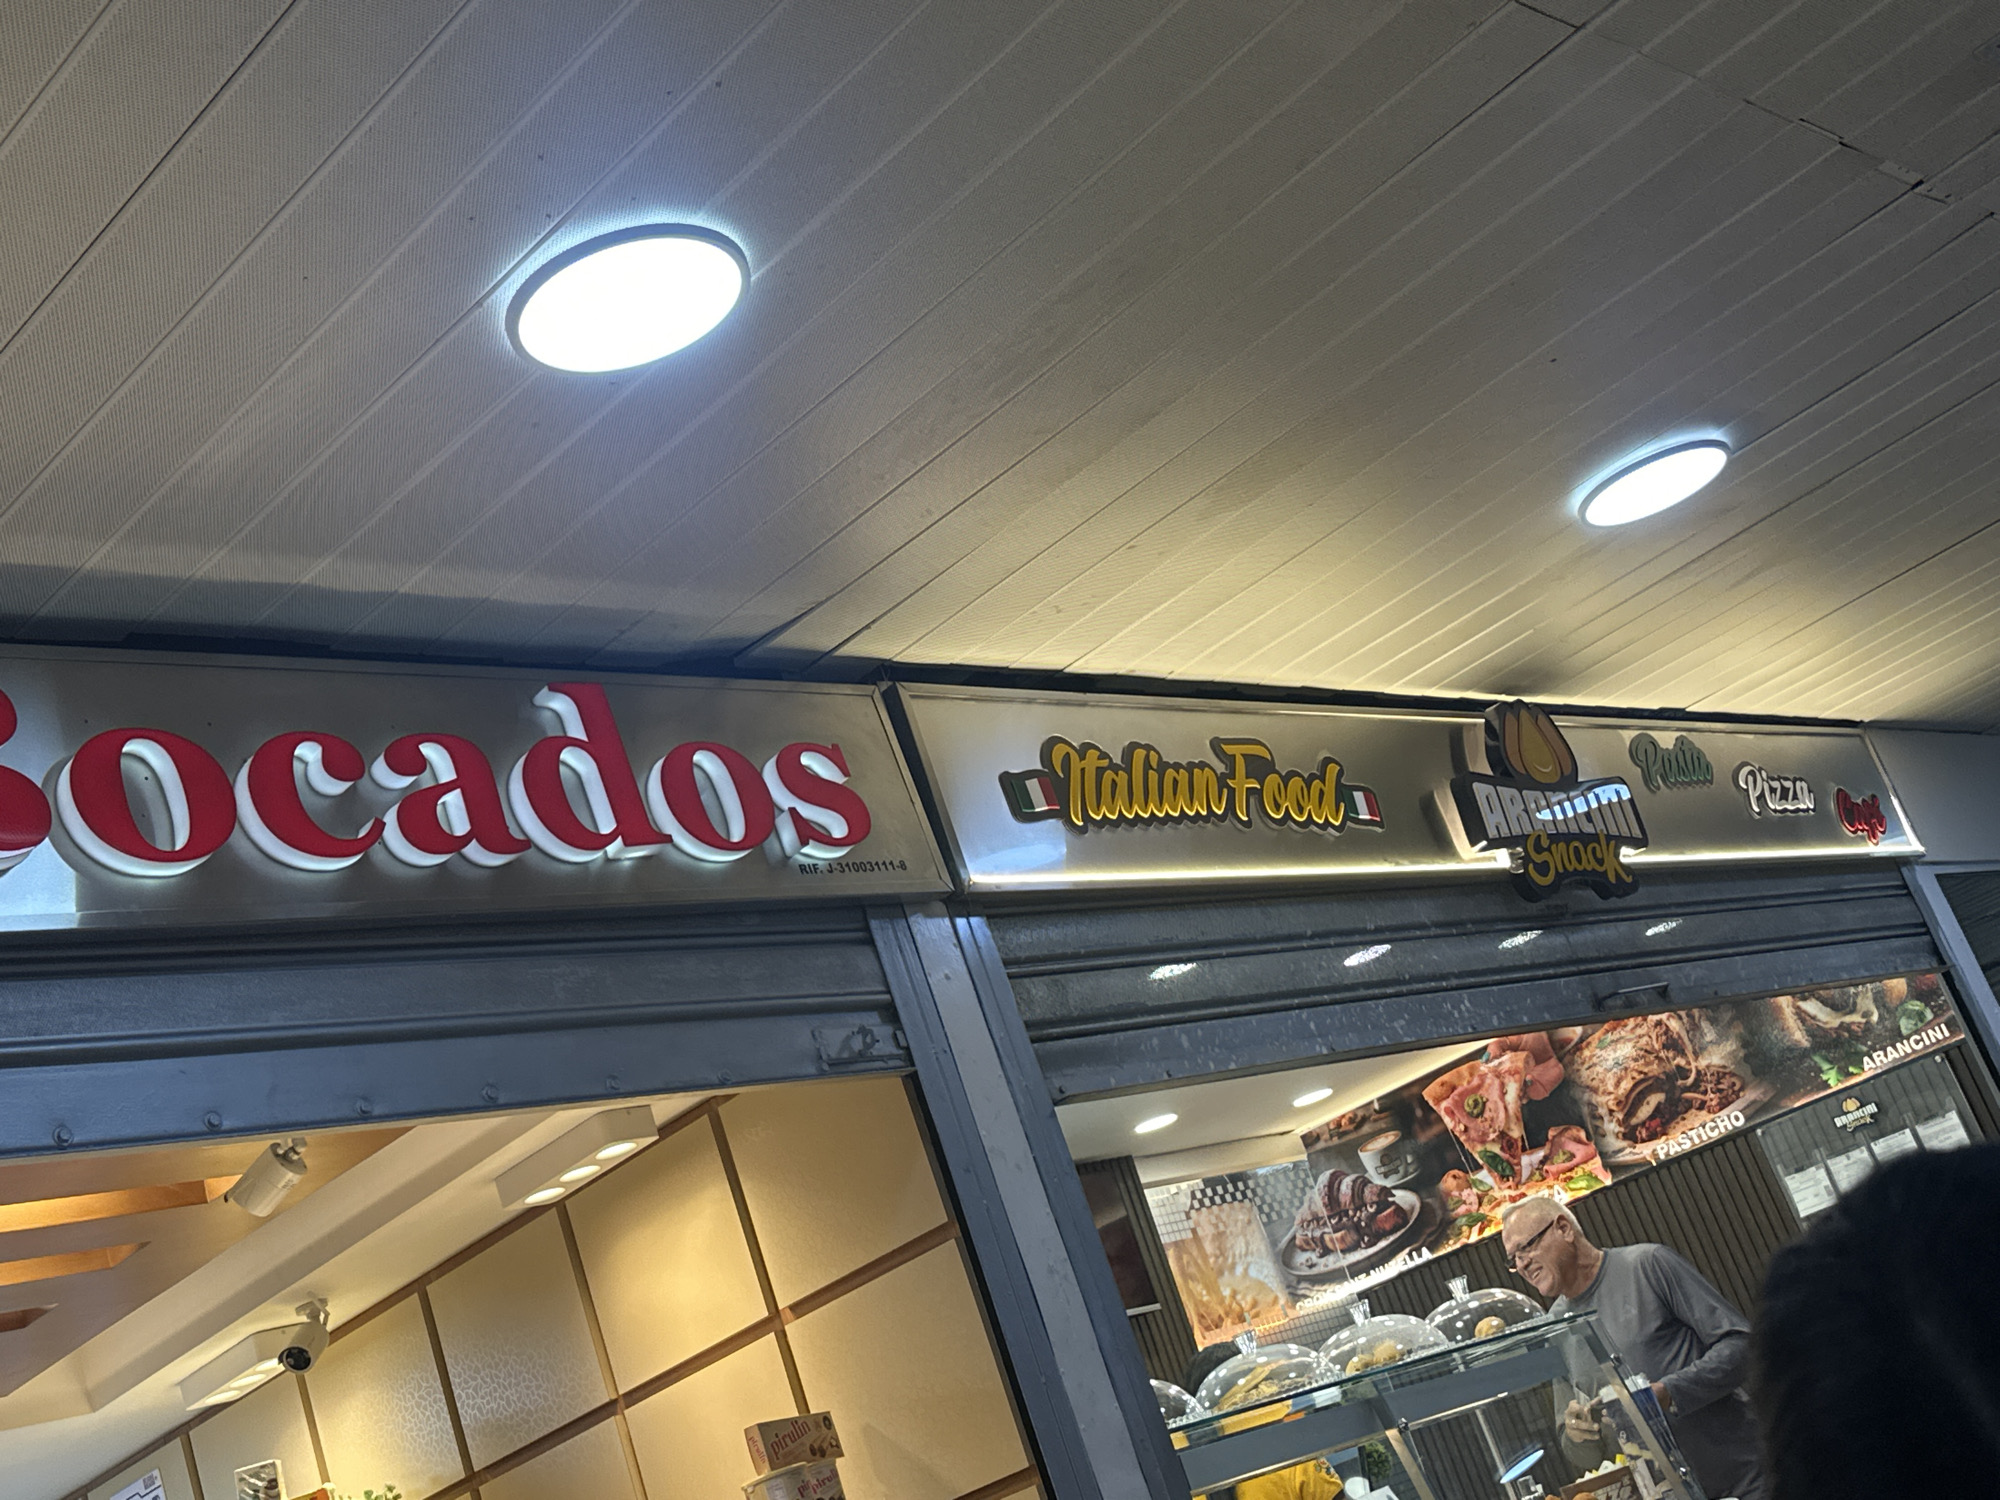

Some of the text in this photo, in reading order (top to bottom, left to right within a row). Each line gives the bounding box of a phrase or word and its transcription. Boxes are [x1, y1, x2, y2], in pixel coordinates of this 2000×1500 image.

[1051, 742, 1345, 827] Italian Food
[1634, 736, 1713, 788] Pasta
[1471, 781, 1644, 840] ARANCINI
[1738, 763, 1815, 814] Pizza
[798, 859, 908, 876] RIF. J-31003111-8
[1527, 829, 1633, 887] Snack
[1862, 1023, 1951, 1071] ARANCINI
[1656, 1111, 1746, 1160] PASTICHO
[770, 1419, 812, 1461] pirulin
